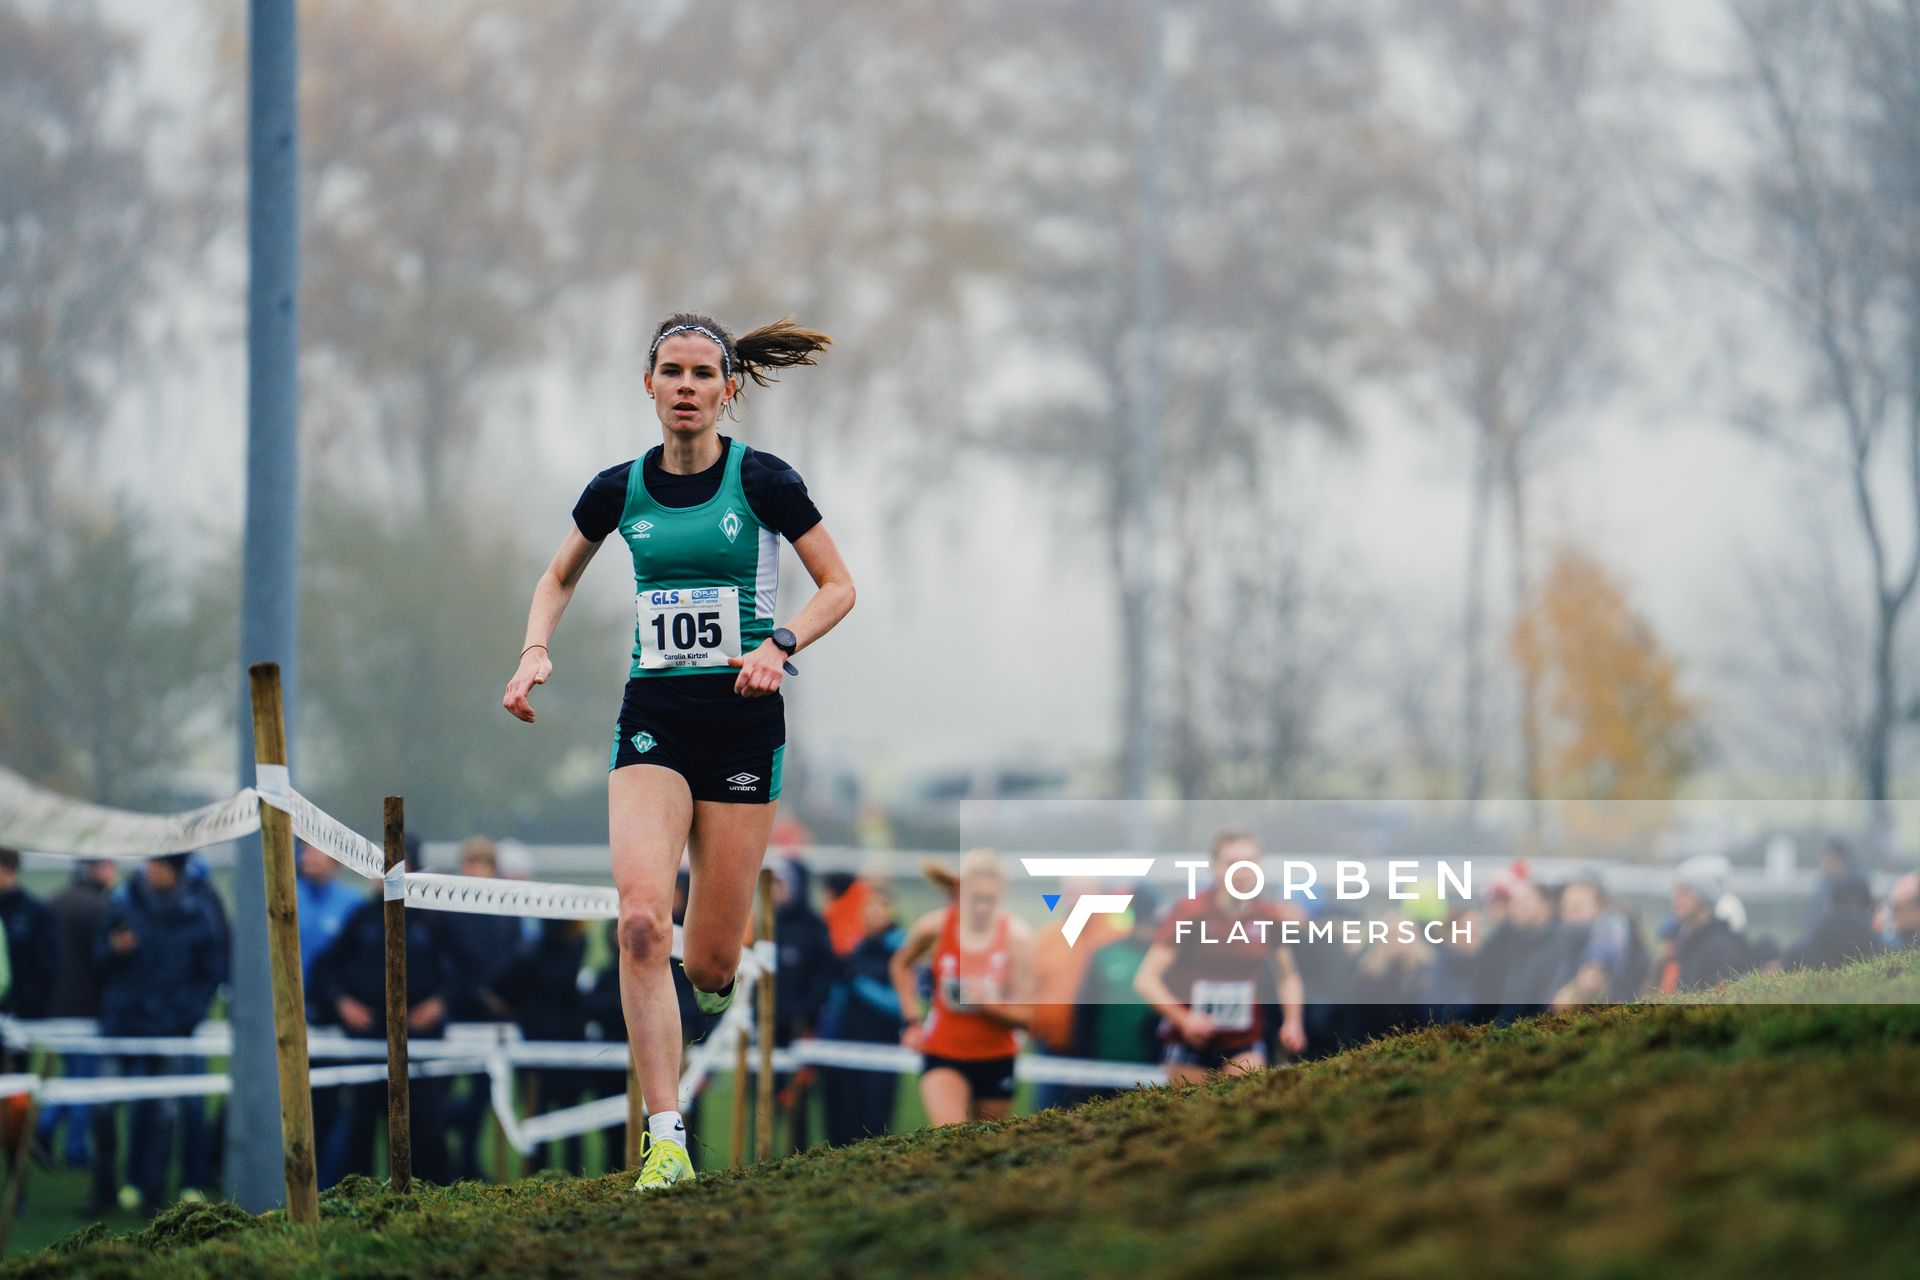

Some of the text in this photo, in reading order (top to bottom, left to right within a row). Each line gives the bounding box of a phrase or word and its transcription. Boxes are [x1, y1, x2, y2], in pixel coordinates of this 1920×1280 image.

[651, 612, 722, 650] 105
[687, 651, 708, 659] Kirtzel
[729, 784, 757, 792] umbro
